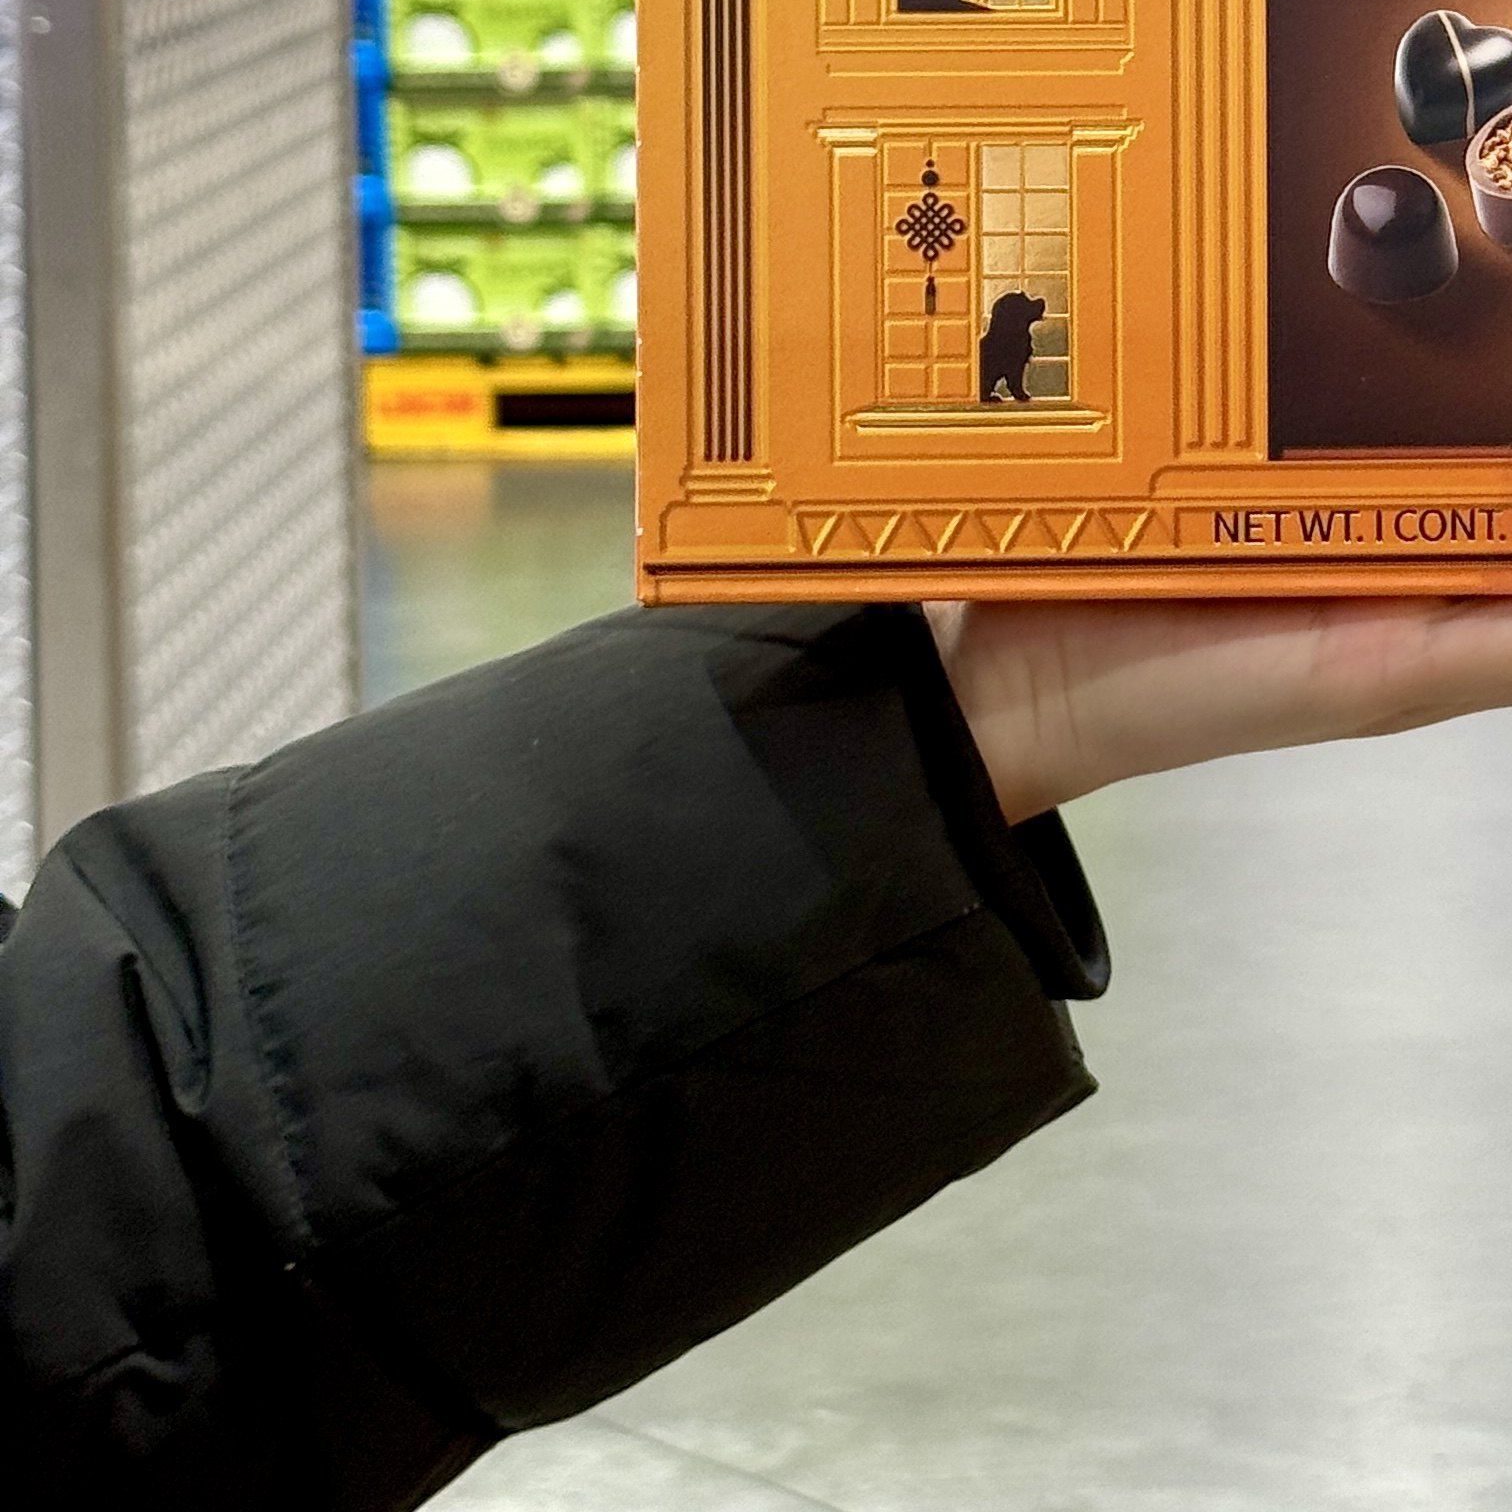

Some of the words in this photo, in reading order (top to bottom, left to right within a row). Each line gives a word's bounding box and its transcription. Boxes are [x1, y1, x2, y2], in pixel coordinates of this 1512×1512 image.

[1214, 510, 1291, 543] NET
[1299, 510, 1364, 543] WT.
[1394, 508, 1506, 542] CONT.
